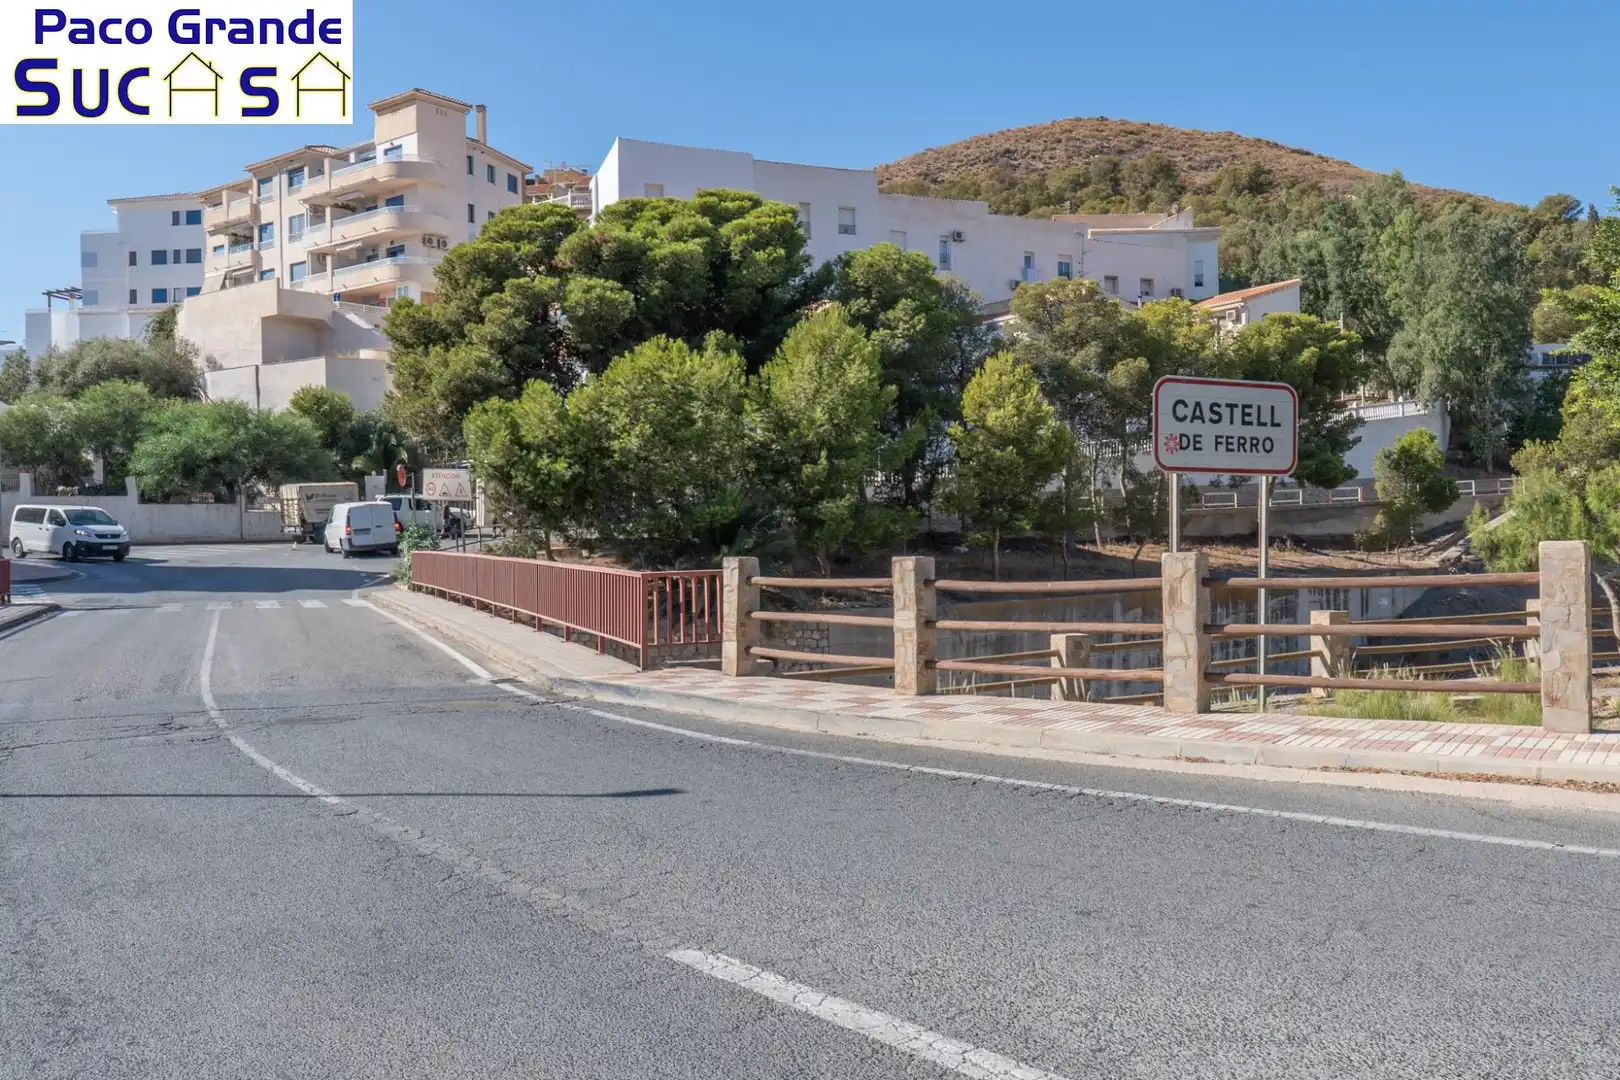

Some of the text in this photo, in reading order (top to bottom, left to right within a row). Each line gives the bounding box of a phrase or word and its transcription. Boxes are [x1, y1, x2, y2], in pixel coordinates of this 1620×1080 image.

[1172, 399, 1282, 428] CASTELL
[1179, 433, 1275, 454] DE FERRO
